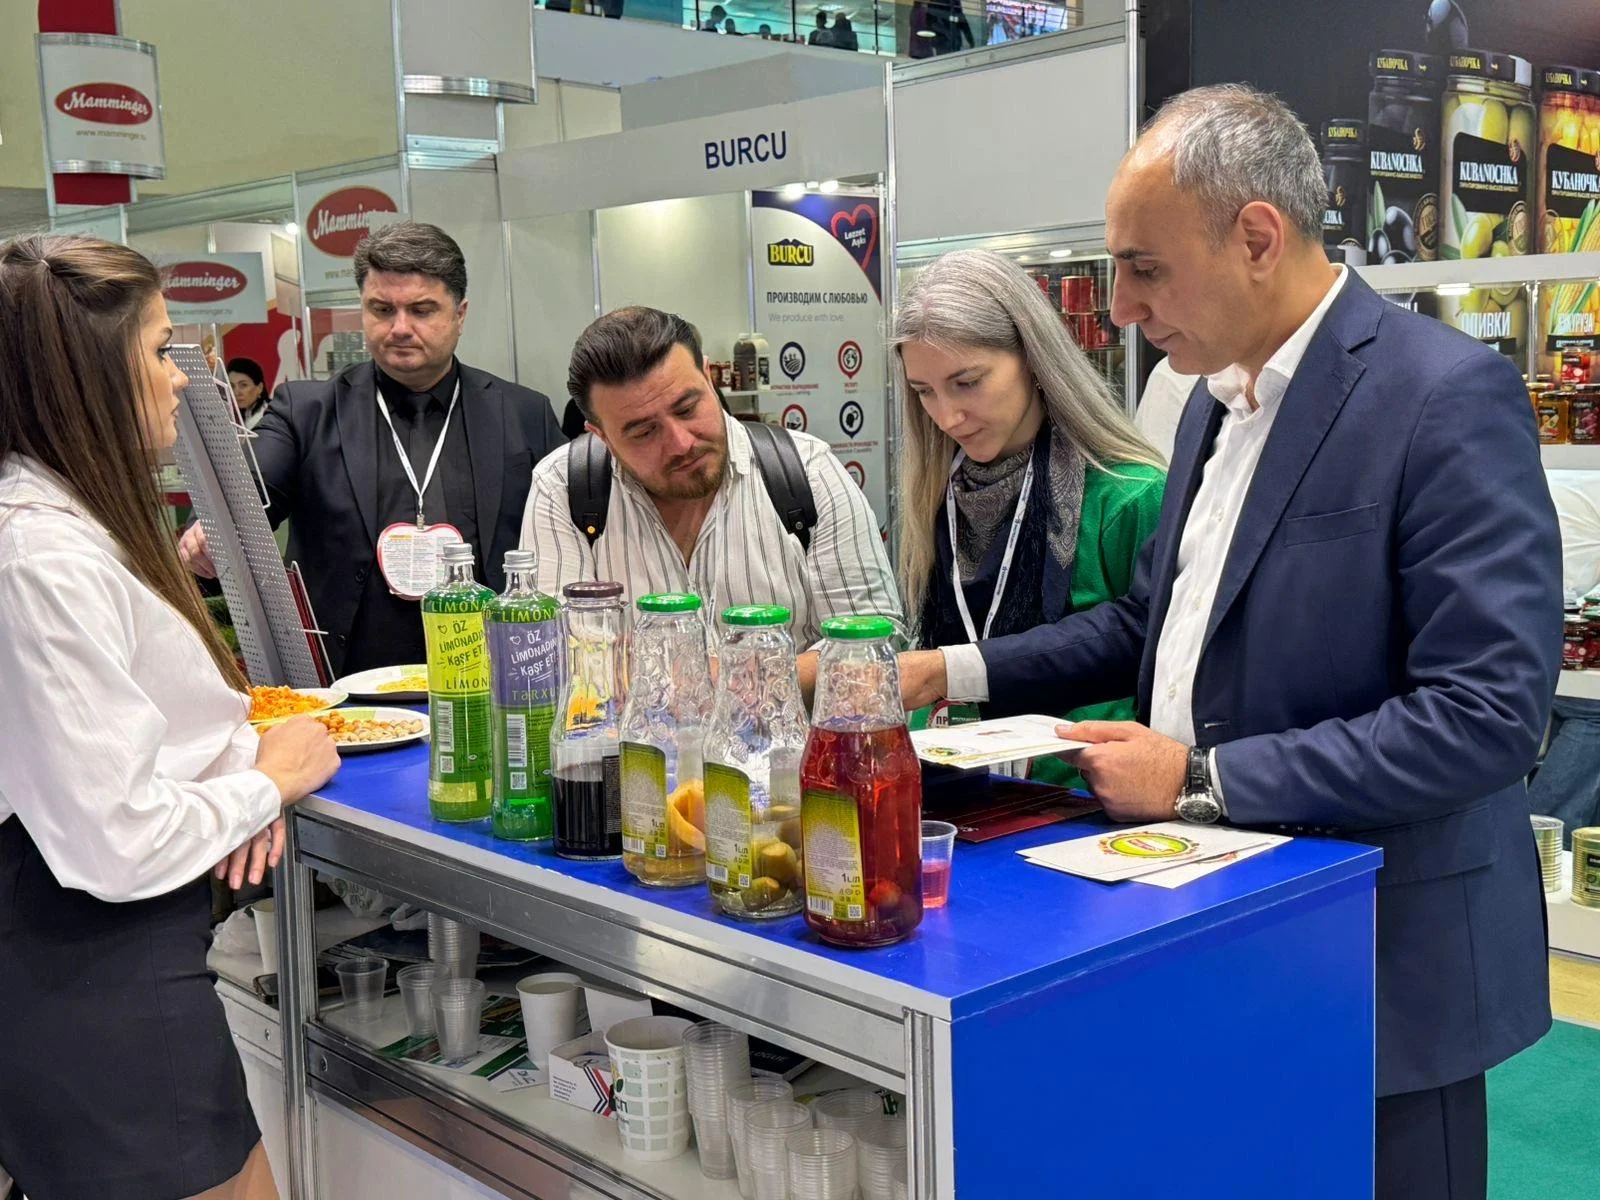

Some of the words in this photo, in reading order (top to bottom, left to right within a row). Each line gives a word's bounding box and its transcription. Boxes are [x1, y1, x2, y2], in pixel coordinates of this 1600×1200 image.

[64, 91, 149, 116] Mamminger
[705, 131, 788, 169] BURCU
[1370, 151, 1423, 173] KUBANOCHKA
[1460, 161, 1519, 185] KUBANOCHKA
[770, 244, 813, 265] BURCU
[767, 291, 822, 306] ПРОИЗВОДИМ
[822, 292, 828, 304] С
[828, 292, 868, 304] ЛЮБОВЬЮ
[452, 619, 468, 634] ÖZ
[527, 629, 541, 644] ÖZ
